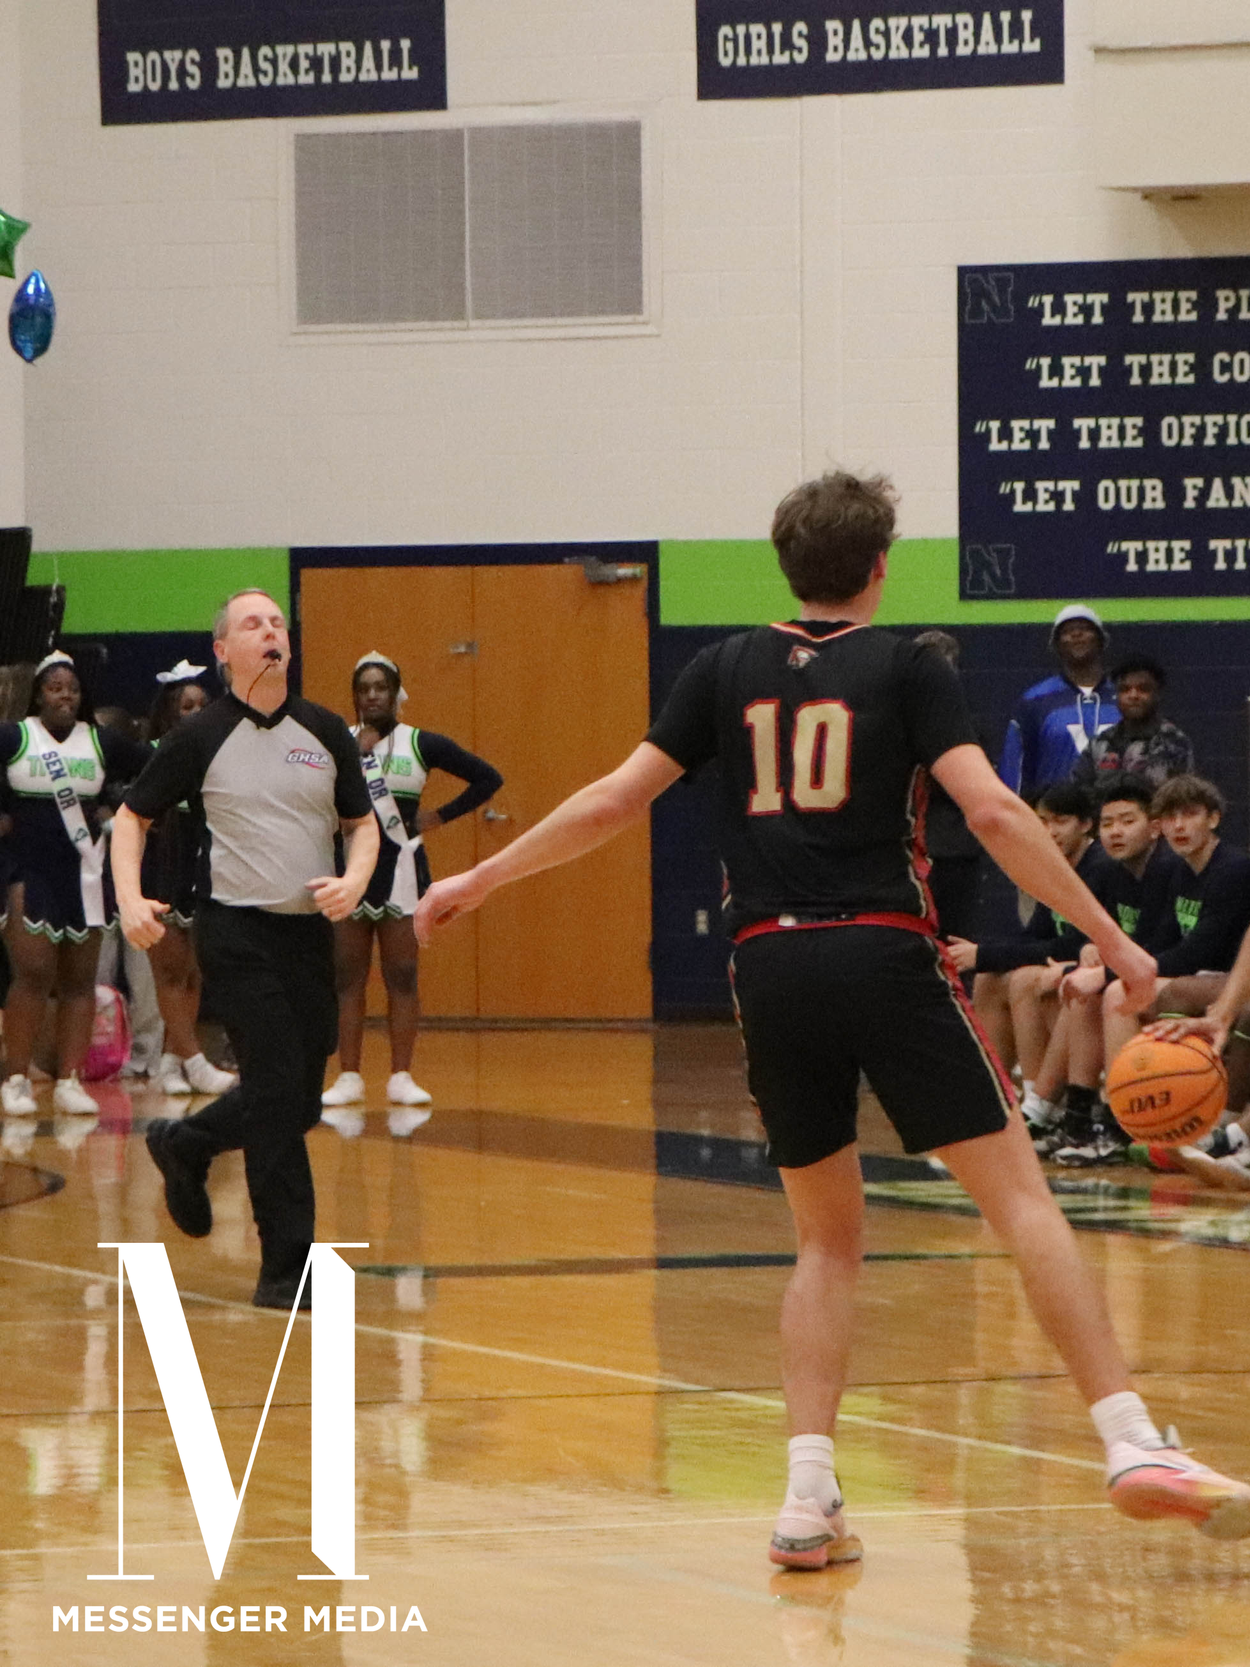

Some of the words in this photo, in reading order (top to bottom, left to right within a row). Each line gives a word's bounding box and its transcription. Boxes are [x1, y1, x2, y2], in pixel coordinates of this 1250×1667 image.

[717, 22, 809, 67] GIRLS
[825, 10, 1041, 63] BASKETBALL
[126, 49, 202, 92] BOYS
[215, 38, 419, 89] BASKETBALL
[1126, 290, 1198, 323] THE
[1124, 353, 1196, 385] THE
[1072, 416, 1144, 449] THE
[1097, 478, 1166, 511] OUR
[286, 751, 330, 765] GHSA
[743, 699, 854, 815] 10
